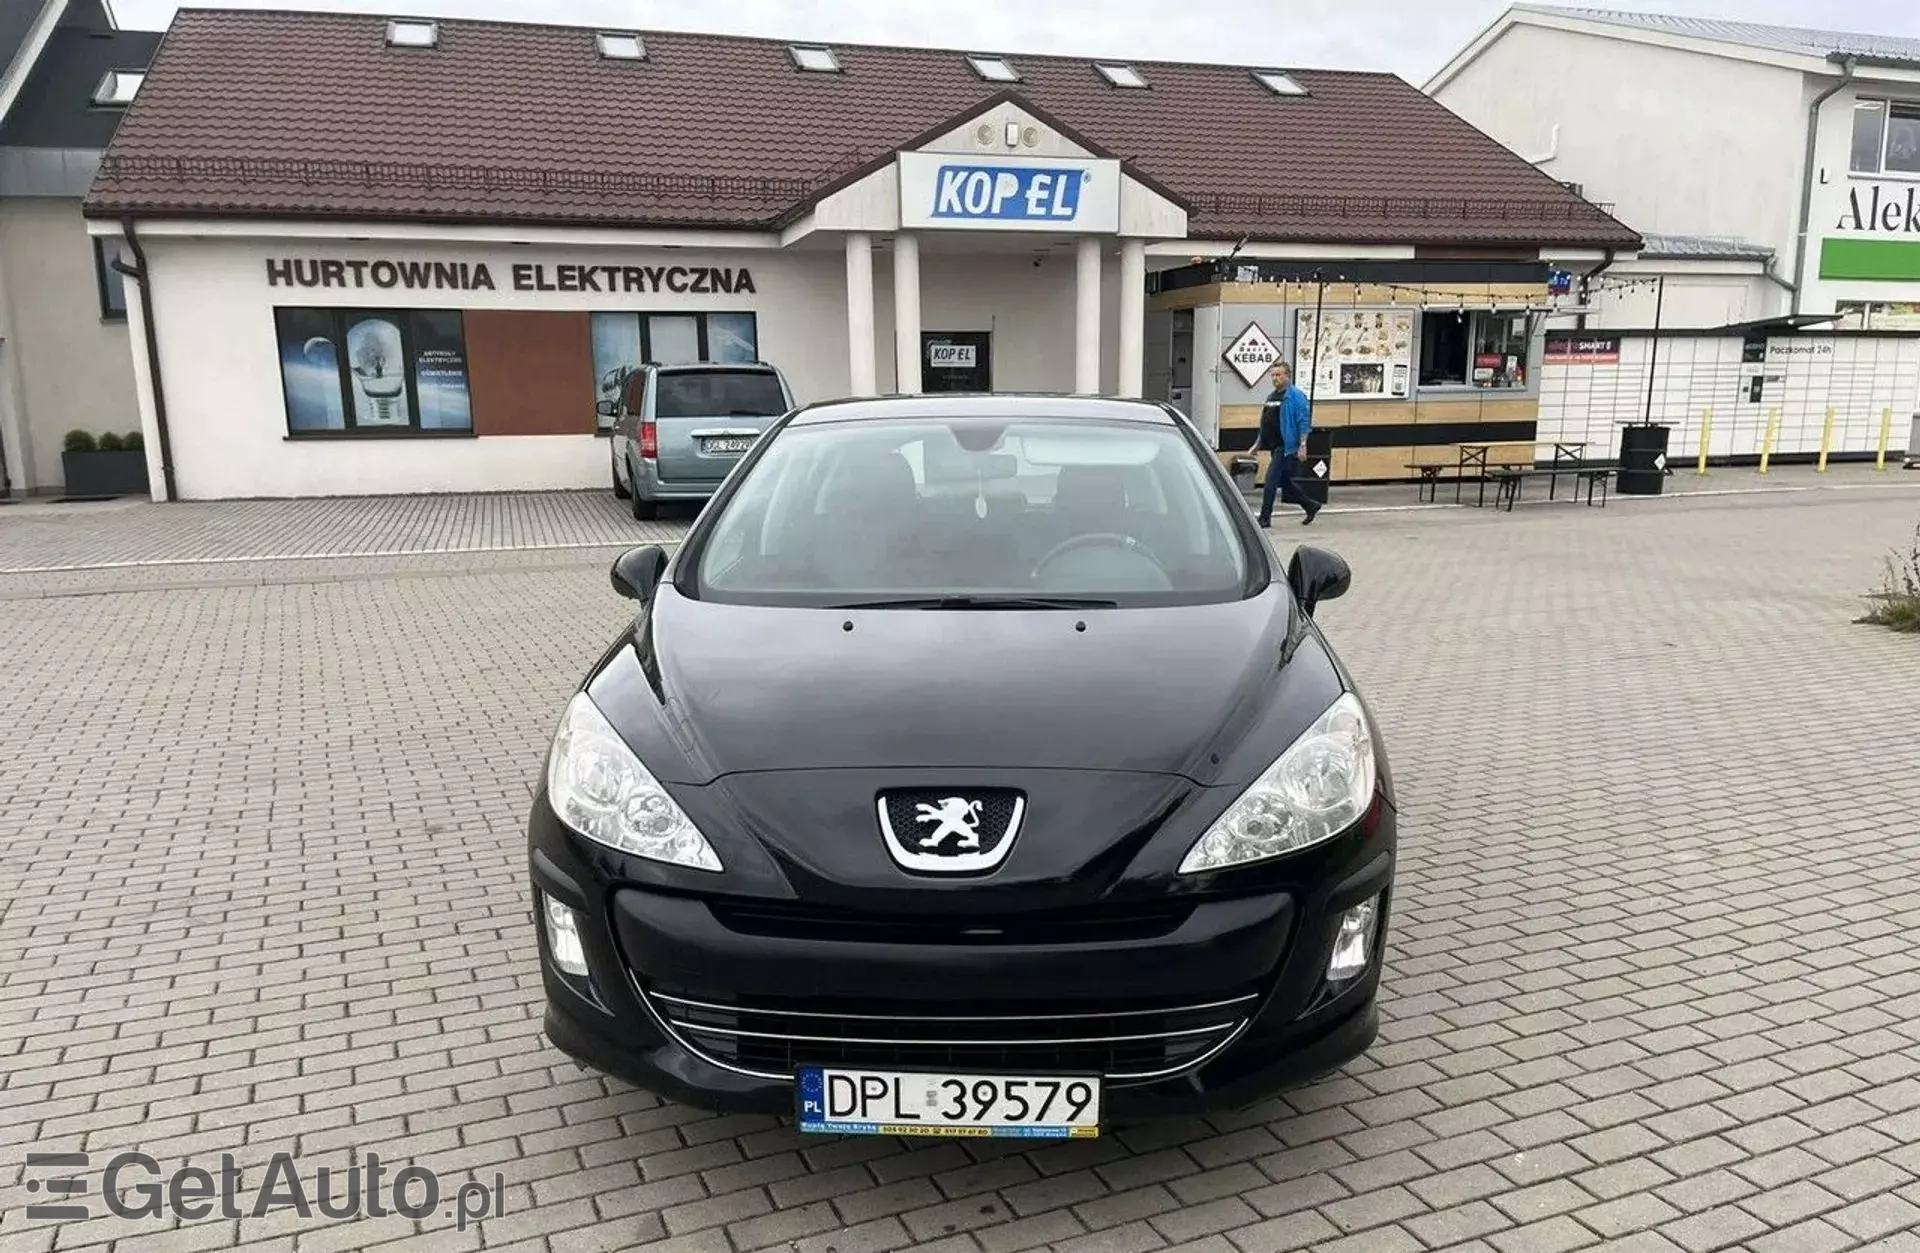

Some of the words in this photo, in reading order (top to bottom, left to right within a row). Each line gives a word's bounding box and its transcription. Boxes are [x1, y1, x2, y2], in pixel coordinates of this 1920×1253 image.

[938, 170, 1019, 214] KOP
[1025, 174, 1074, 217] EL
[266, 258, 496, 290] HURTOWNIA
[512, 264, 756, 293] ELEKTRYCZNA
[933, 347, 956, 360] KOP
[958, 348, 971, 360] EL
[1769, 345, 1815, 355] Paczkomat
[1816, 344, 1832, 354] 24h
[1234, 353, 1272, 363] KEBAB
[828, 1074, 920, 1119] DPL
[940, 1078, 1093, 1122] 39579
[804, 1100, 821, 1113] PL
